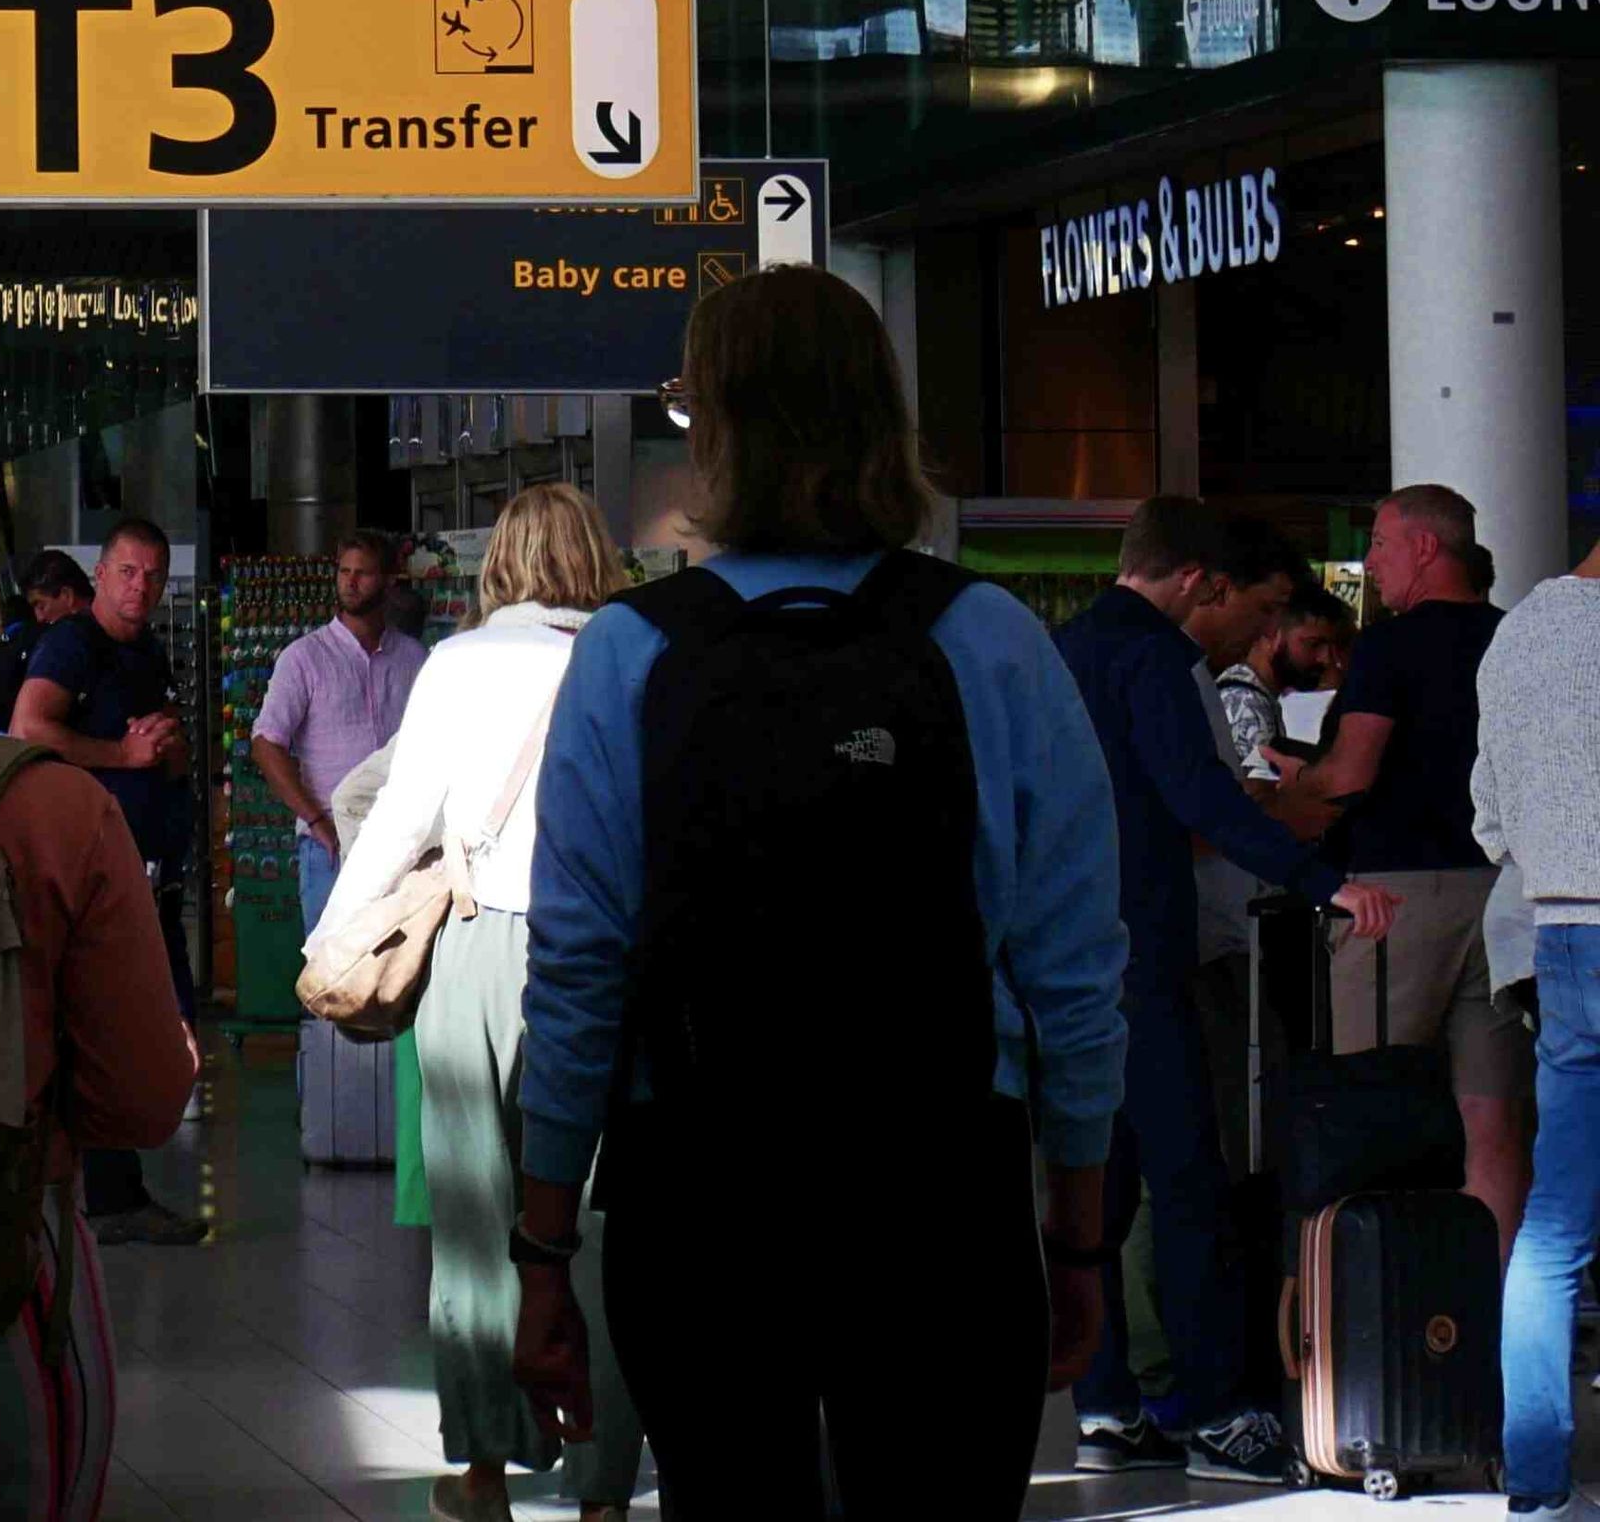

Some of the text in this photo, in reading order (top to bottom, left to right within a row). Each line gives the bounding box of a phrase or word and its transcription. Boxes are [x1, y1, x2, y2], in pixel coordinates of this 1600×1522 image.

[304, 103, 538, 150] Transfer
[1039, 165, 1285, 311] FLOWERS & BULBS
[513, 258, 688, 297] Baby care
